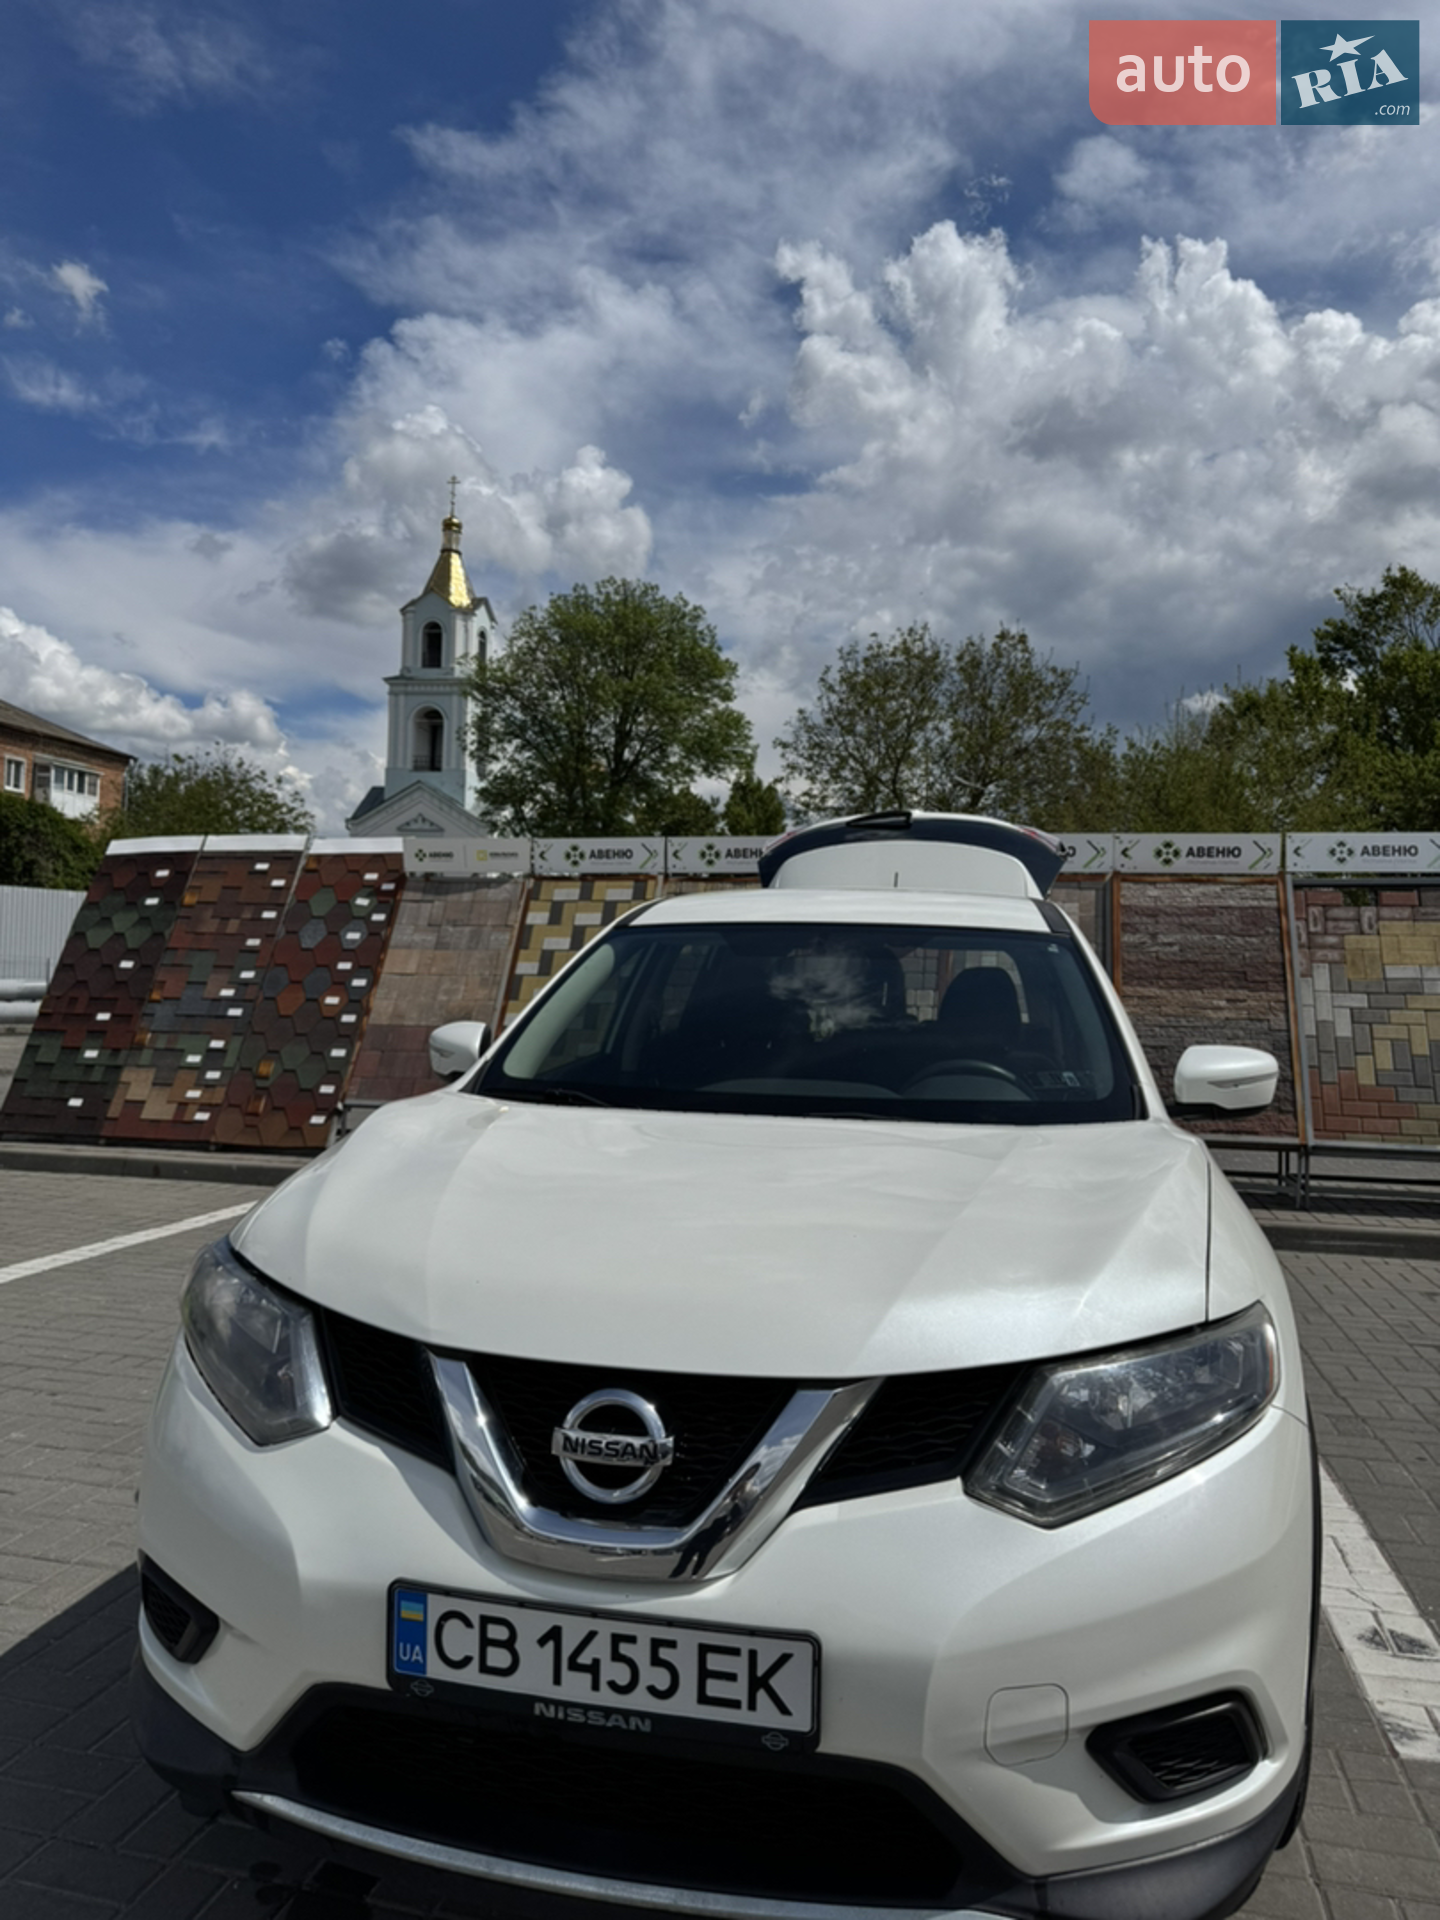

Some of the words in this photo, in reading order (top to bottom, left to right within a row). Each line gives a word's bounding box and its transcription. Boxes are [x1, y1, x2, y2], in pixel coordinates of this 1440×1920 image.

[589, 848, 634, 860] АВЕНЮ
[1183, 846, 1242, 859] АВЕНЮ
[1360, 844, 1419, 858] АВЕНЮ
[562, 1436, 659, 1461] NISSAN
[399, 1641, 425, 1665] UA
[433, 1609, 521, 1678] CB
[536, 1624, 680, 1701] 1455
[696, 1642, 796, 1717] EK
[533, 1702, 652, 1733] NISSAN
